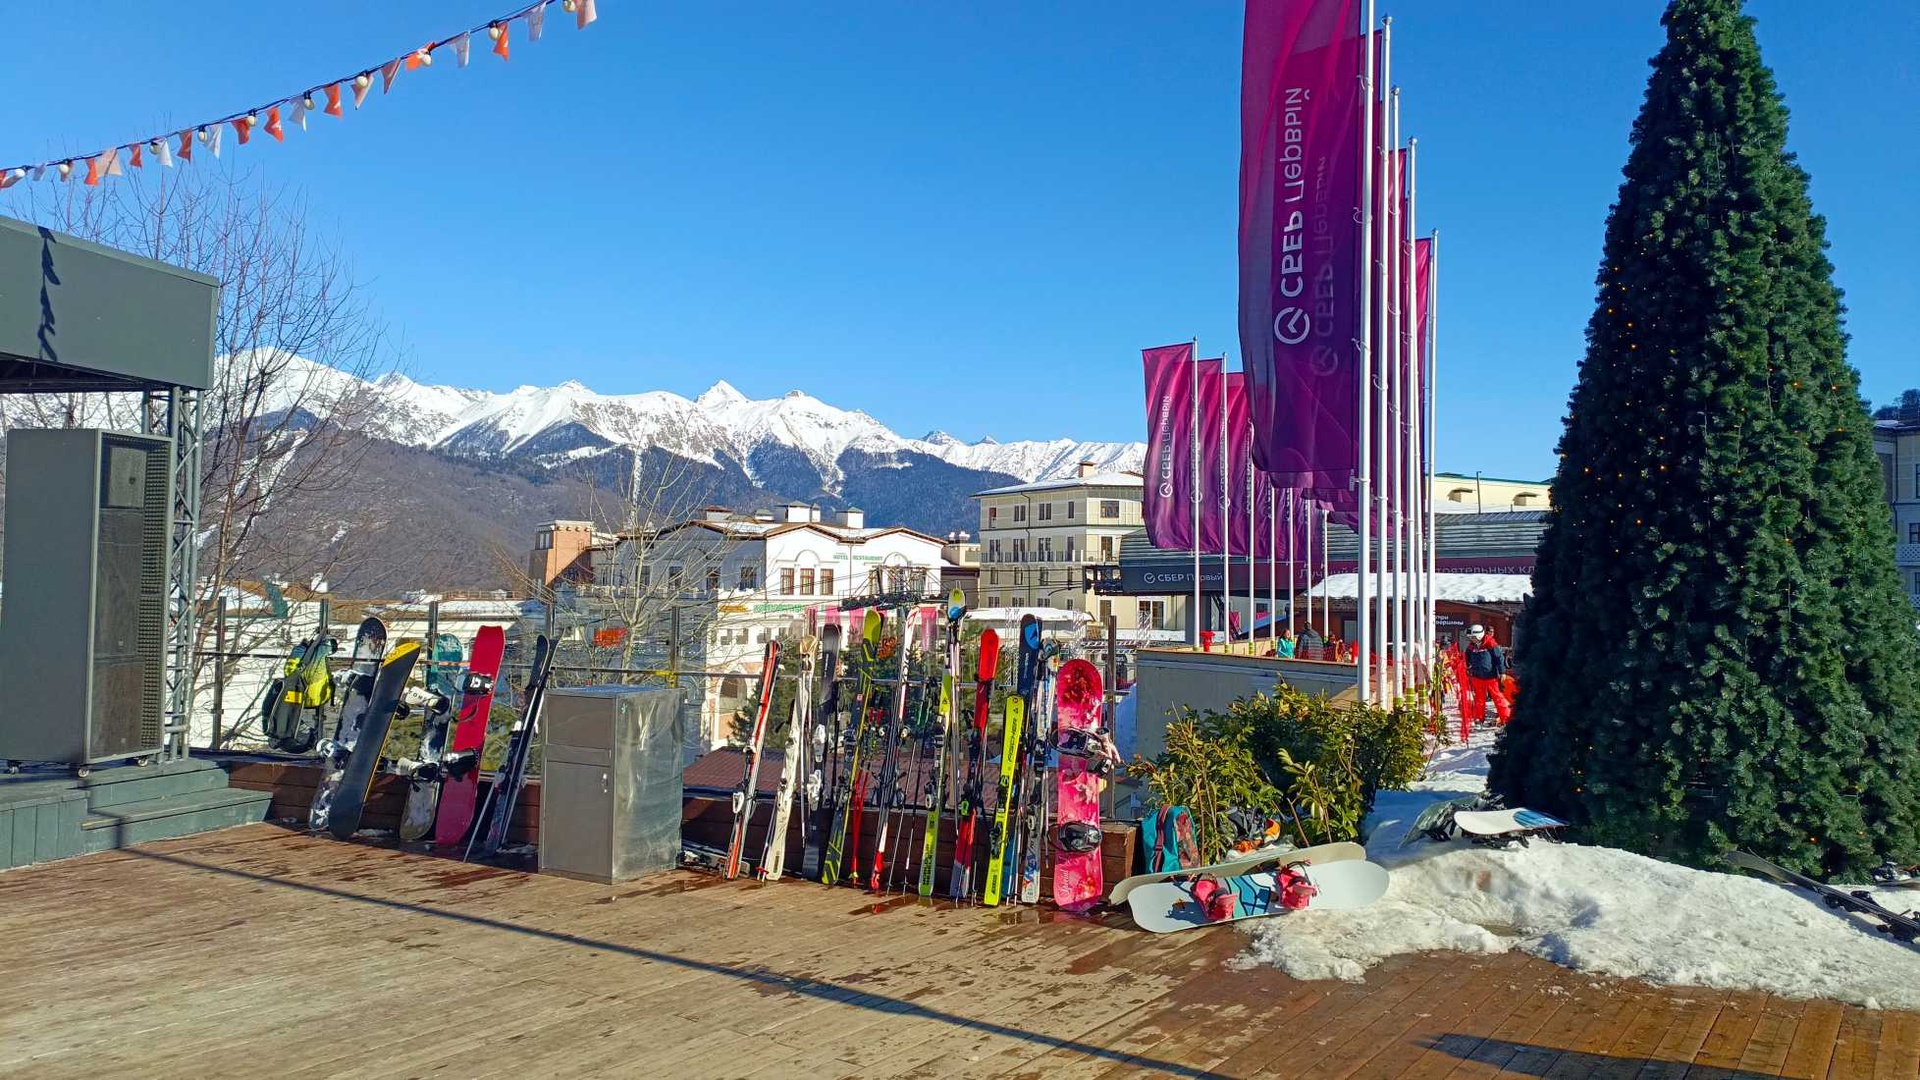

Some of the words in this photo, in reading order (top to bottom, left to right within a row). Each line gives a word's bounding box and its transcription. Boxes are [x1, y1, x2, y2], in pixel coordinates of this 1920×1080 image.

[1157, 573, 1184, 582] СБЕР
[1186, 572, 1223, 583] Првый
[1007, 718, 1018, 763] FISCHER
